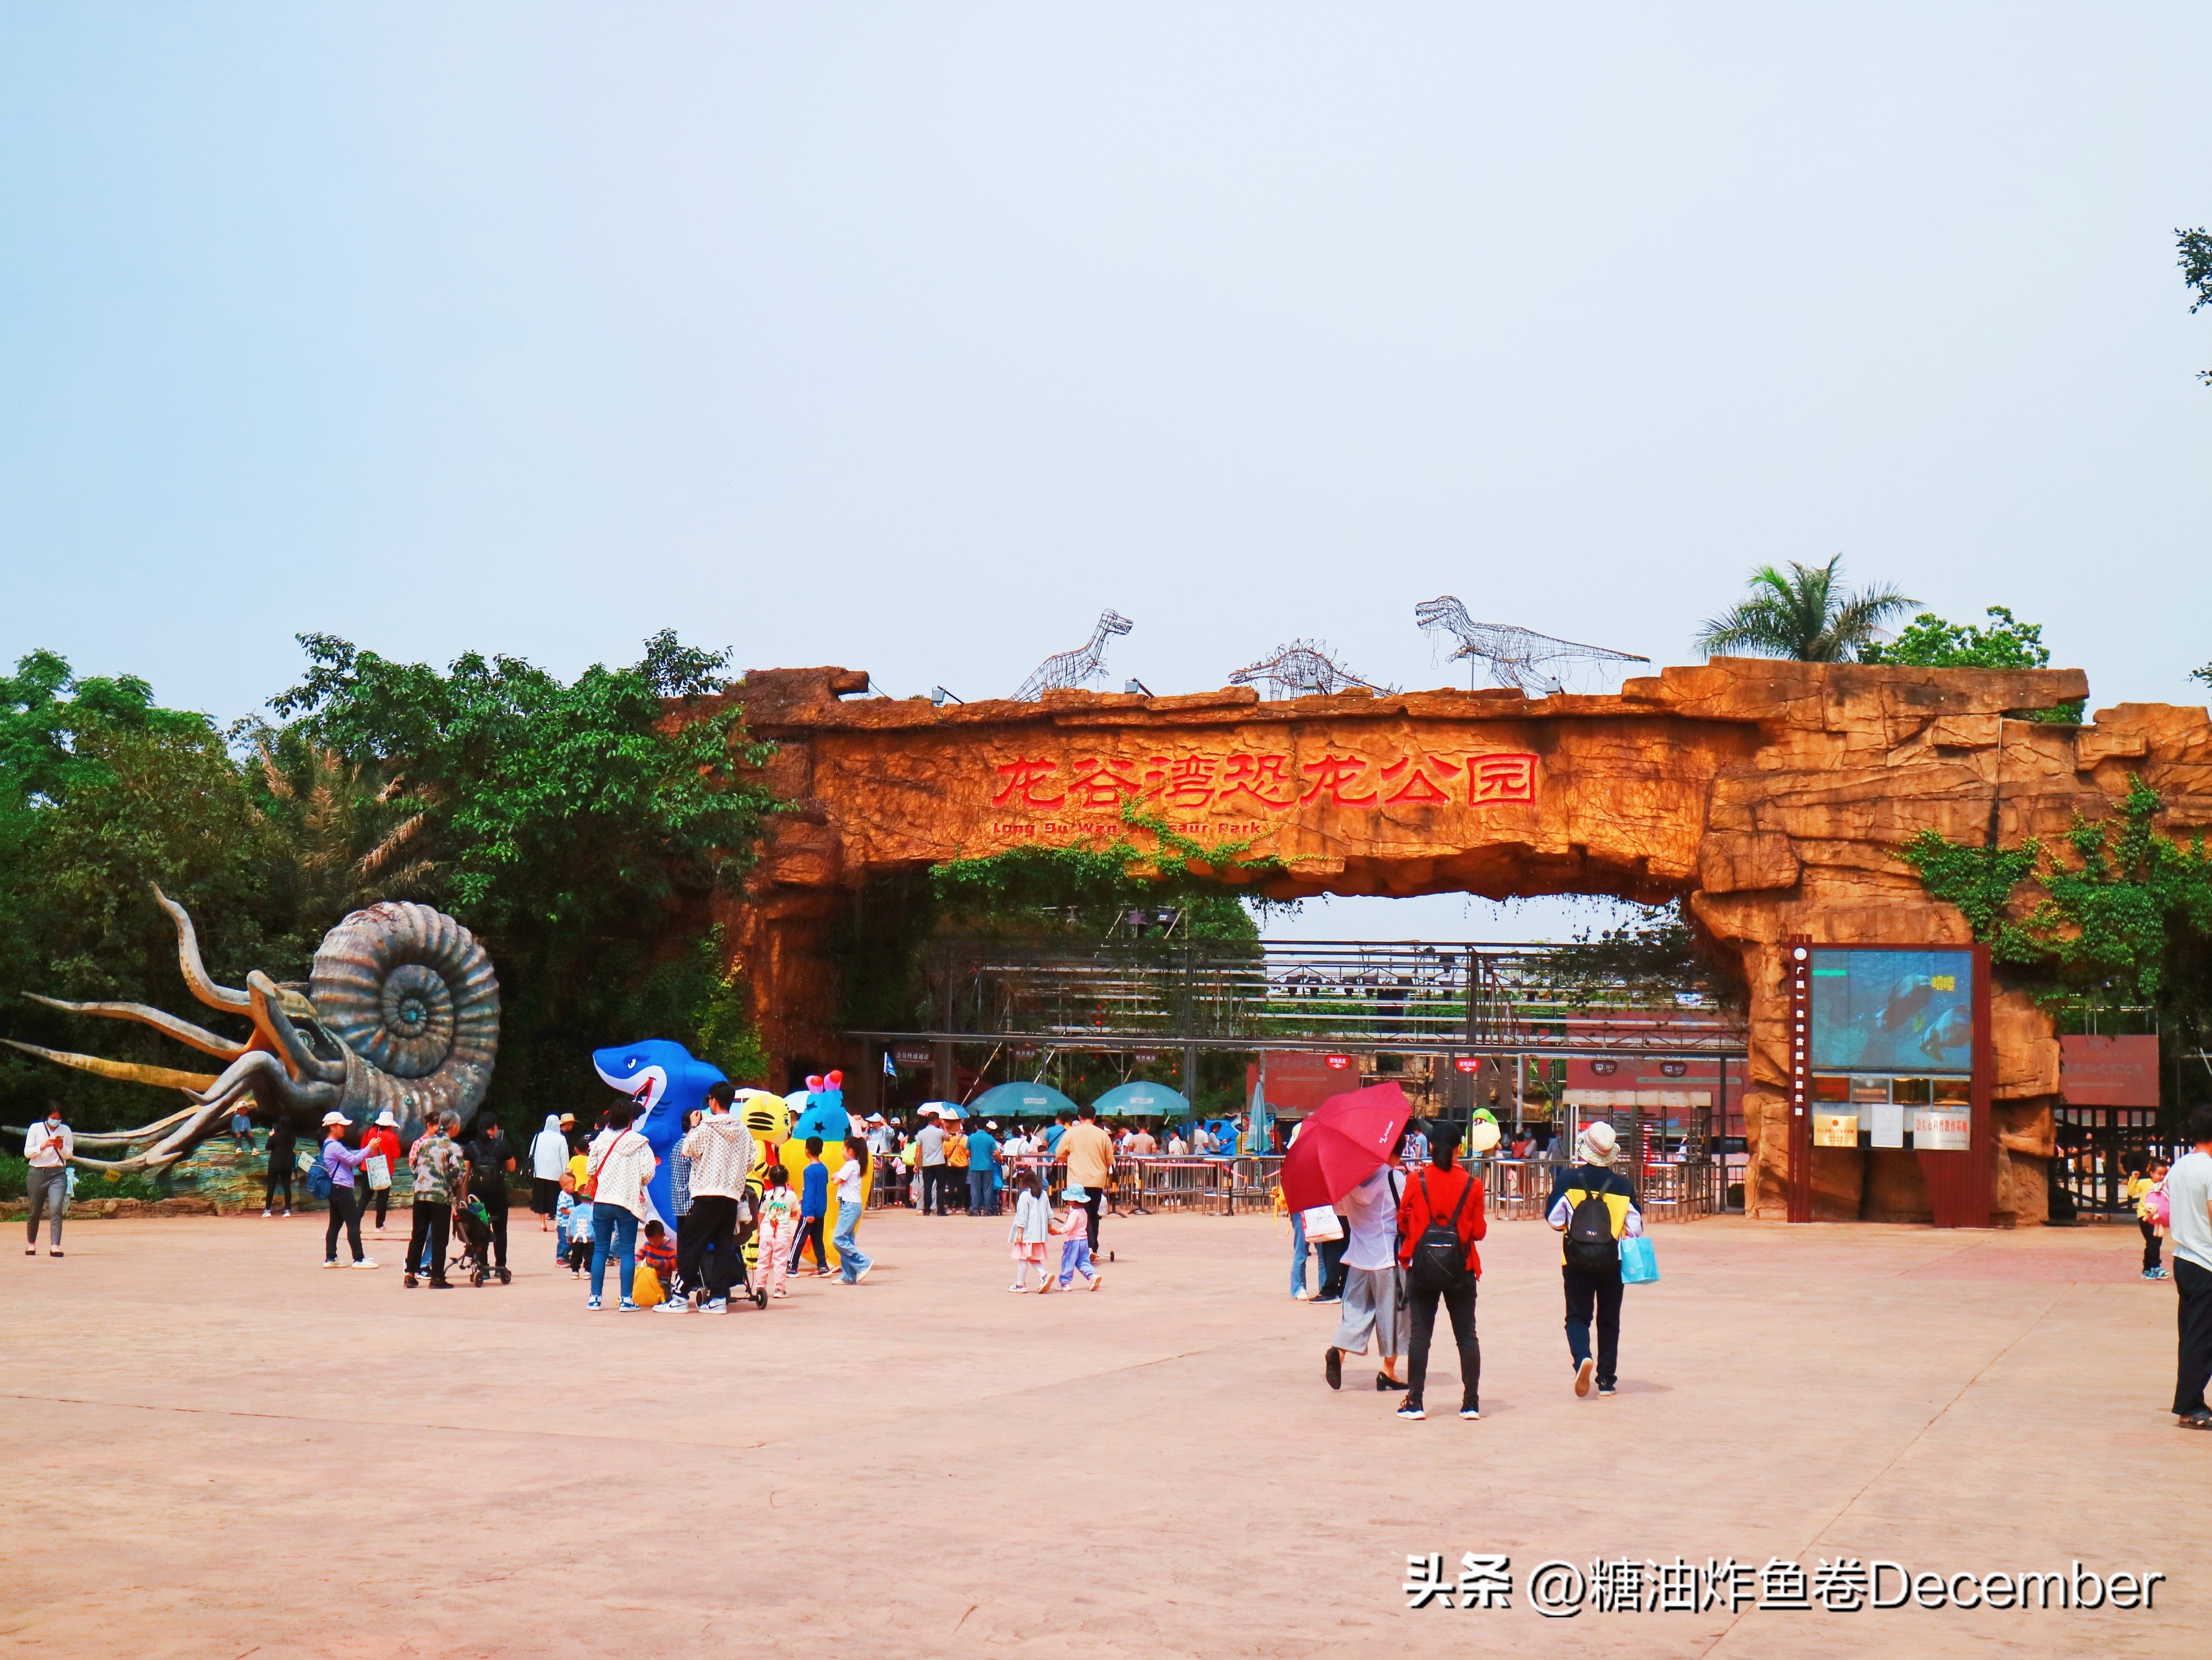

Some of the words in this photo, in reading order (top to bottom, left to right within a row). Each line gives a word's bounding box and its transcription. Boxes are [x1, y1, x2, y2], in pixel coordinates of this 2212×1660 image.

[992, 754, 1538, 810] 龙谷湾恐龙公园
[993, 823, 1035, 838] Long
[1078, 823, 1118, 834] Wan
[1218, 821, 1261, 834] Park
[896, 1052, 929, 1060] 会员快速通道
[1916, 1118, 1968, 1133] 崇左市科普教育基地
